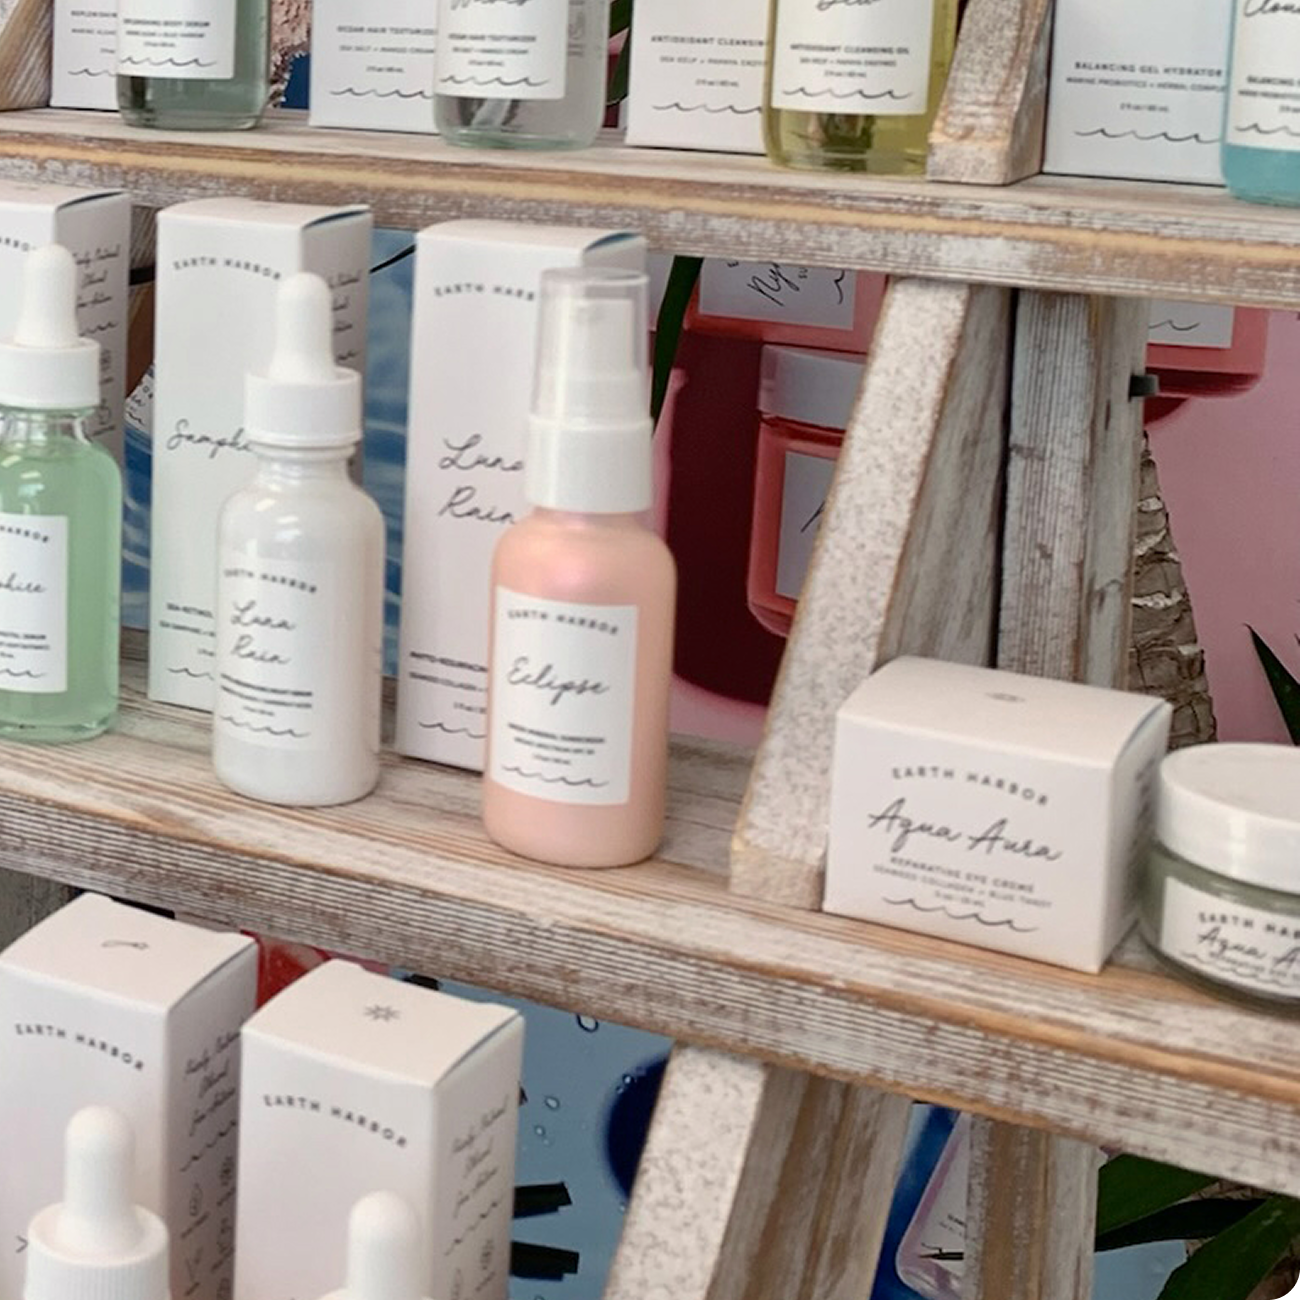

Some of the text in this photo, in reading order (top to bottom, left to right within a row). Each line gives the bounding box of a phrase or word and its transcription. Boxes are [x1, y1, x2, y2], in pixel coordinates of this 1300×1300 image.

[651, 35, 715, 47] ANTIOXIDANT
[1075, 61, 1223, 78] BALANCING GEL HYDRATOR
[173, 256, 282, 281] EARTH HARBOR
[434, 282, 484, 297] EARTH
[260, 571, 318, 594] HARBOR
[508, 607, 619, 637] EARTH HARBOR
[507, 656, 610, 706] Eclipse
[892, 766, 1049, 806] EARTH HARBOR
[867, 796, 1064, 862] Aqua Aura
[890, 855, 961, 880] REPARATIVE
[964, 872, 987, 885] EYE
[1197, 911, 1255, 929] EARTH
[1197, 926, 1268, 958] Aqua
[14, 1022, 146, 1073] EARTH HARBOR
[262, 1093, 408, 1149] EARTH HARBOR
